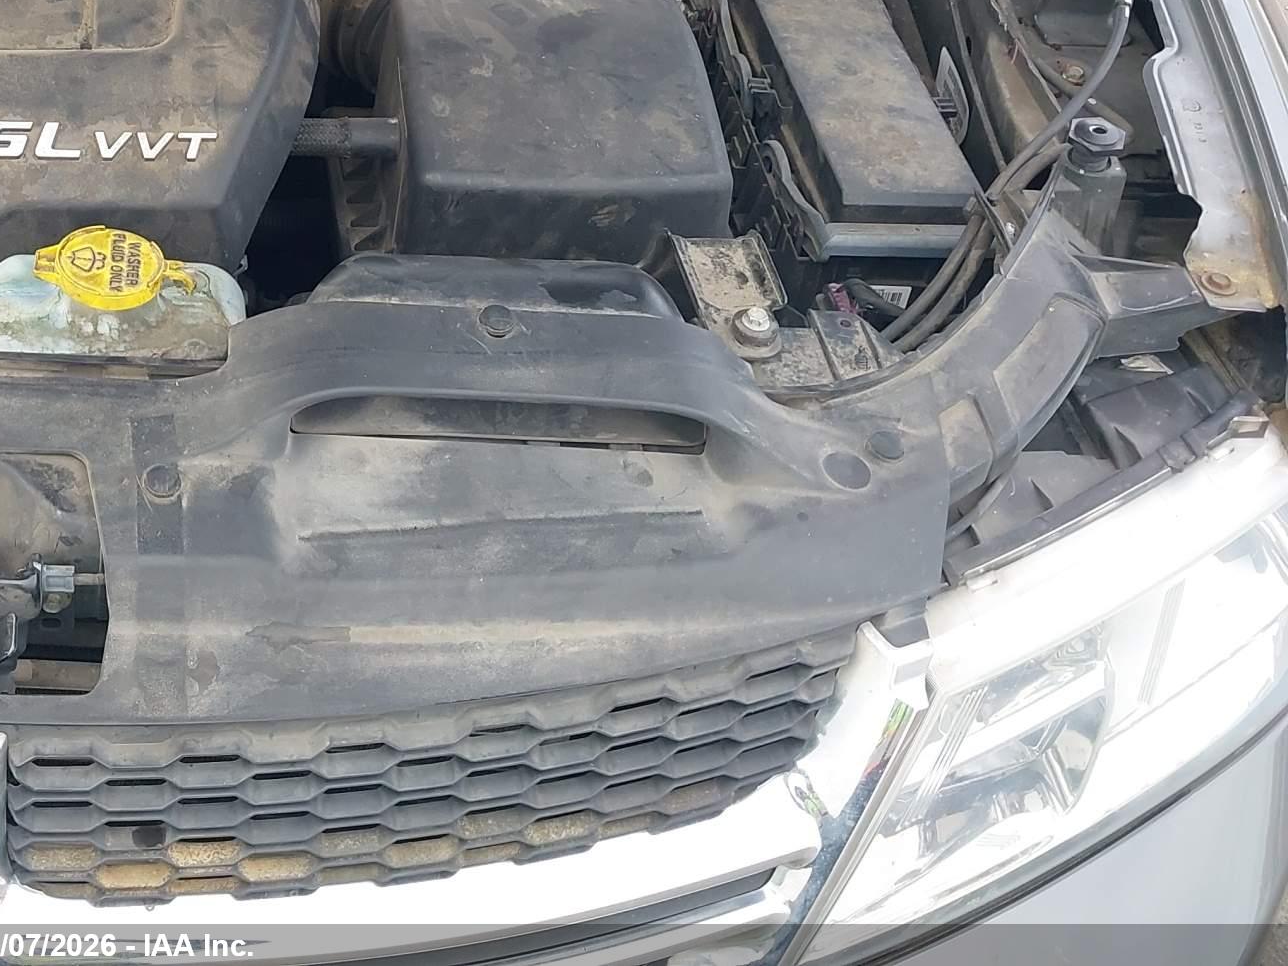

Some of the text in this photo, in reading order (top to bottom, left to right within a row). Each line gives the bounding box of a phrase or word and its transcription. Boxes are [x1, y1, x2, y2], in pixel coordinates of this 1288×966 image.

[93, 131, 218, 161] VVT
[109, 234, 126, 292] FLUID ONLY
[127, 242, 142, 286] WASHER
